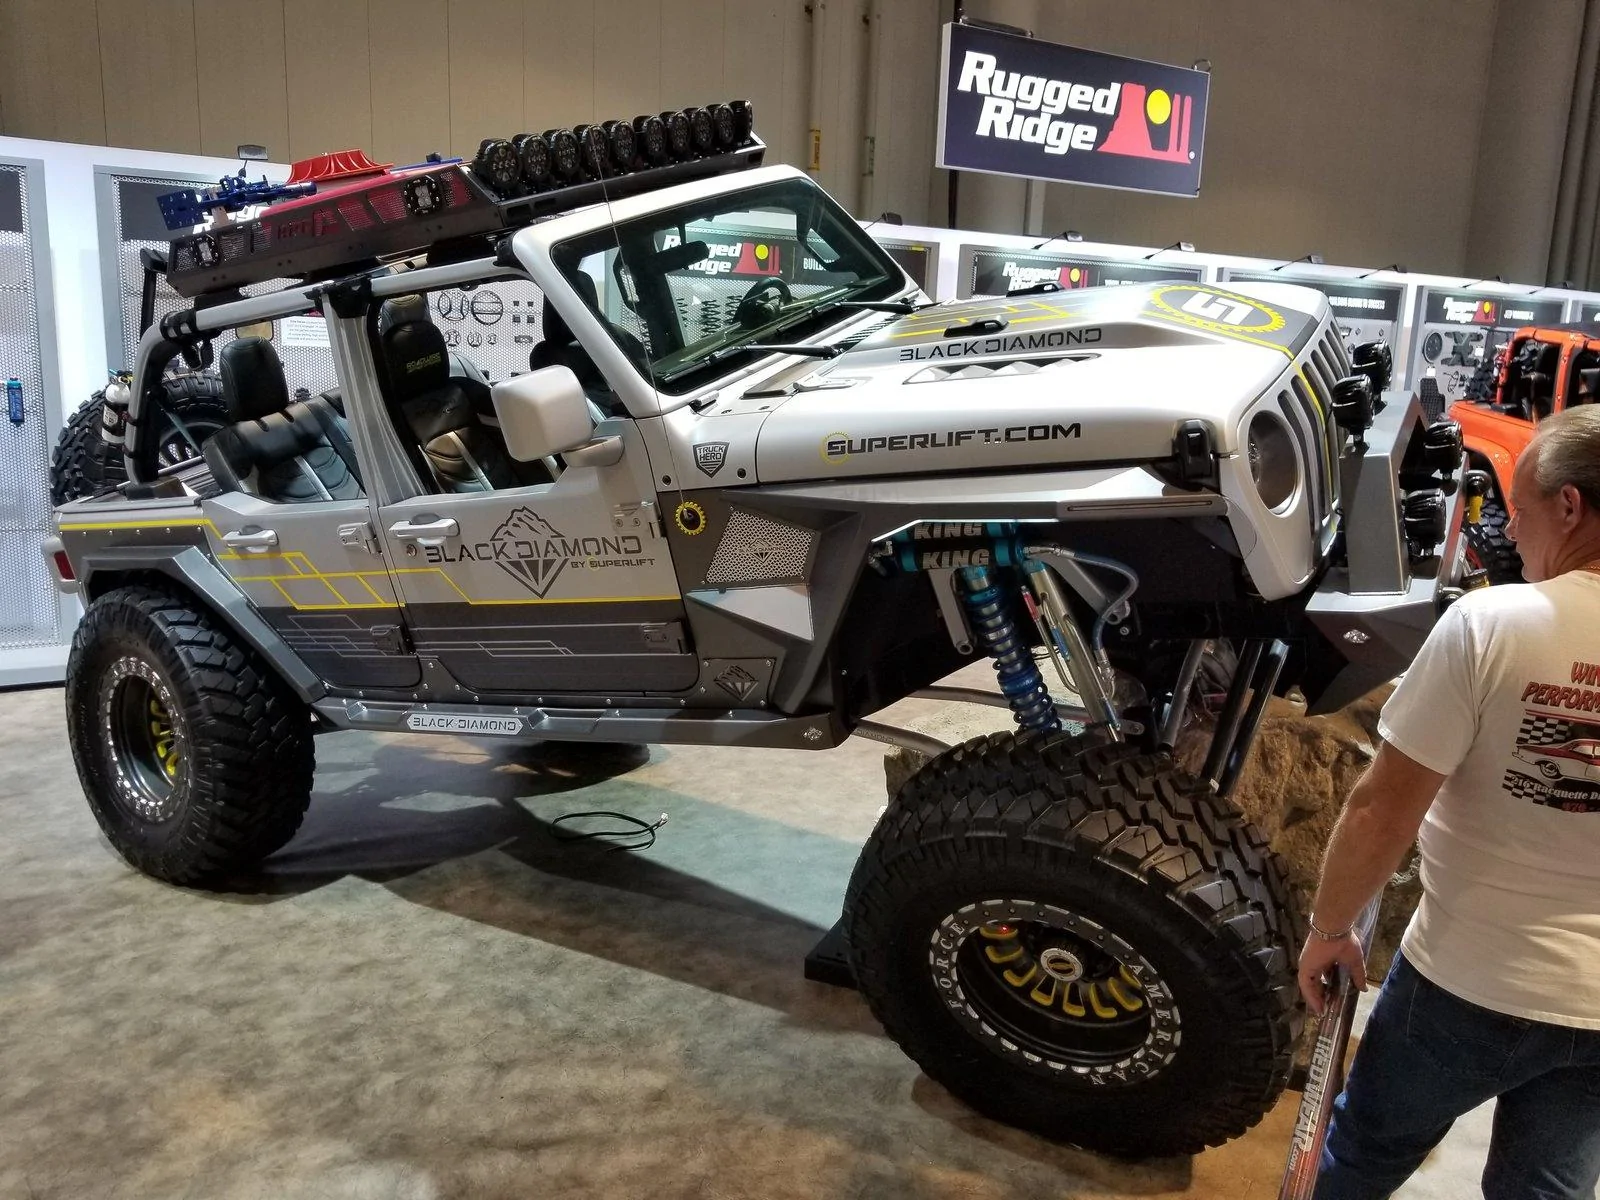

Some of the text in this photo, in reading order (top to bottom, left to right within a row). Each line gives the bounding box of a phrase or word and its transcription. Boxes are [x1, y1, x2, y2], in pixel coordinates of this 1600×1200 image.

[957, 51, 1121, 115] Rugged
[976, 96, 1098, 155] Ridge
[662, 234, 742, 258] Rged
[1003, 262, 1061, 283] Rugged
[900, 327, 1102, 362] BLACK DIAMOND
[827, 422, 1081, 456] SUPERLIFT.COM
[699, 452, 722, 461] HERO
[914, 523, 982, 540] KING
[425, 535, 642, 563] BLACK DIAMOND
[922, 549, 990, 569] KING
[589, 558, 656, 569] SUPERLIFT
[413, 717, 517, 731] BLACK DIAMOND
[1510, 775, 1533, 789] 216
[936, 922, 966, 1010] FORCE
[1091, 964, 1172, 1085] AMERICAN
